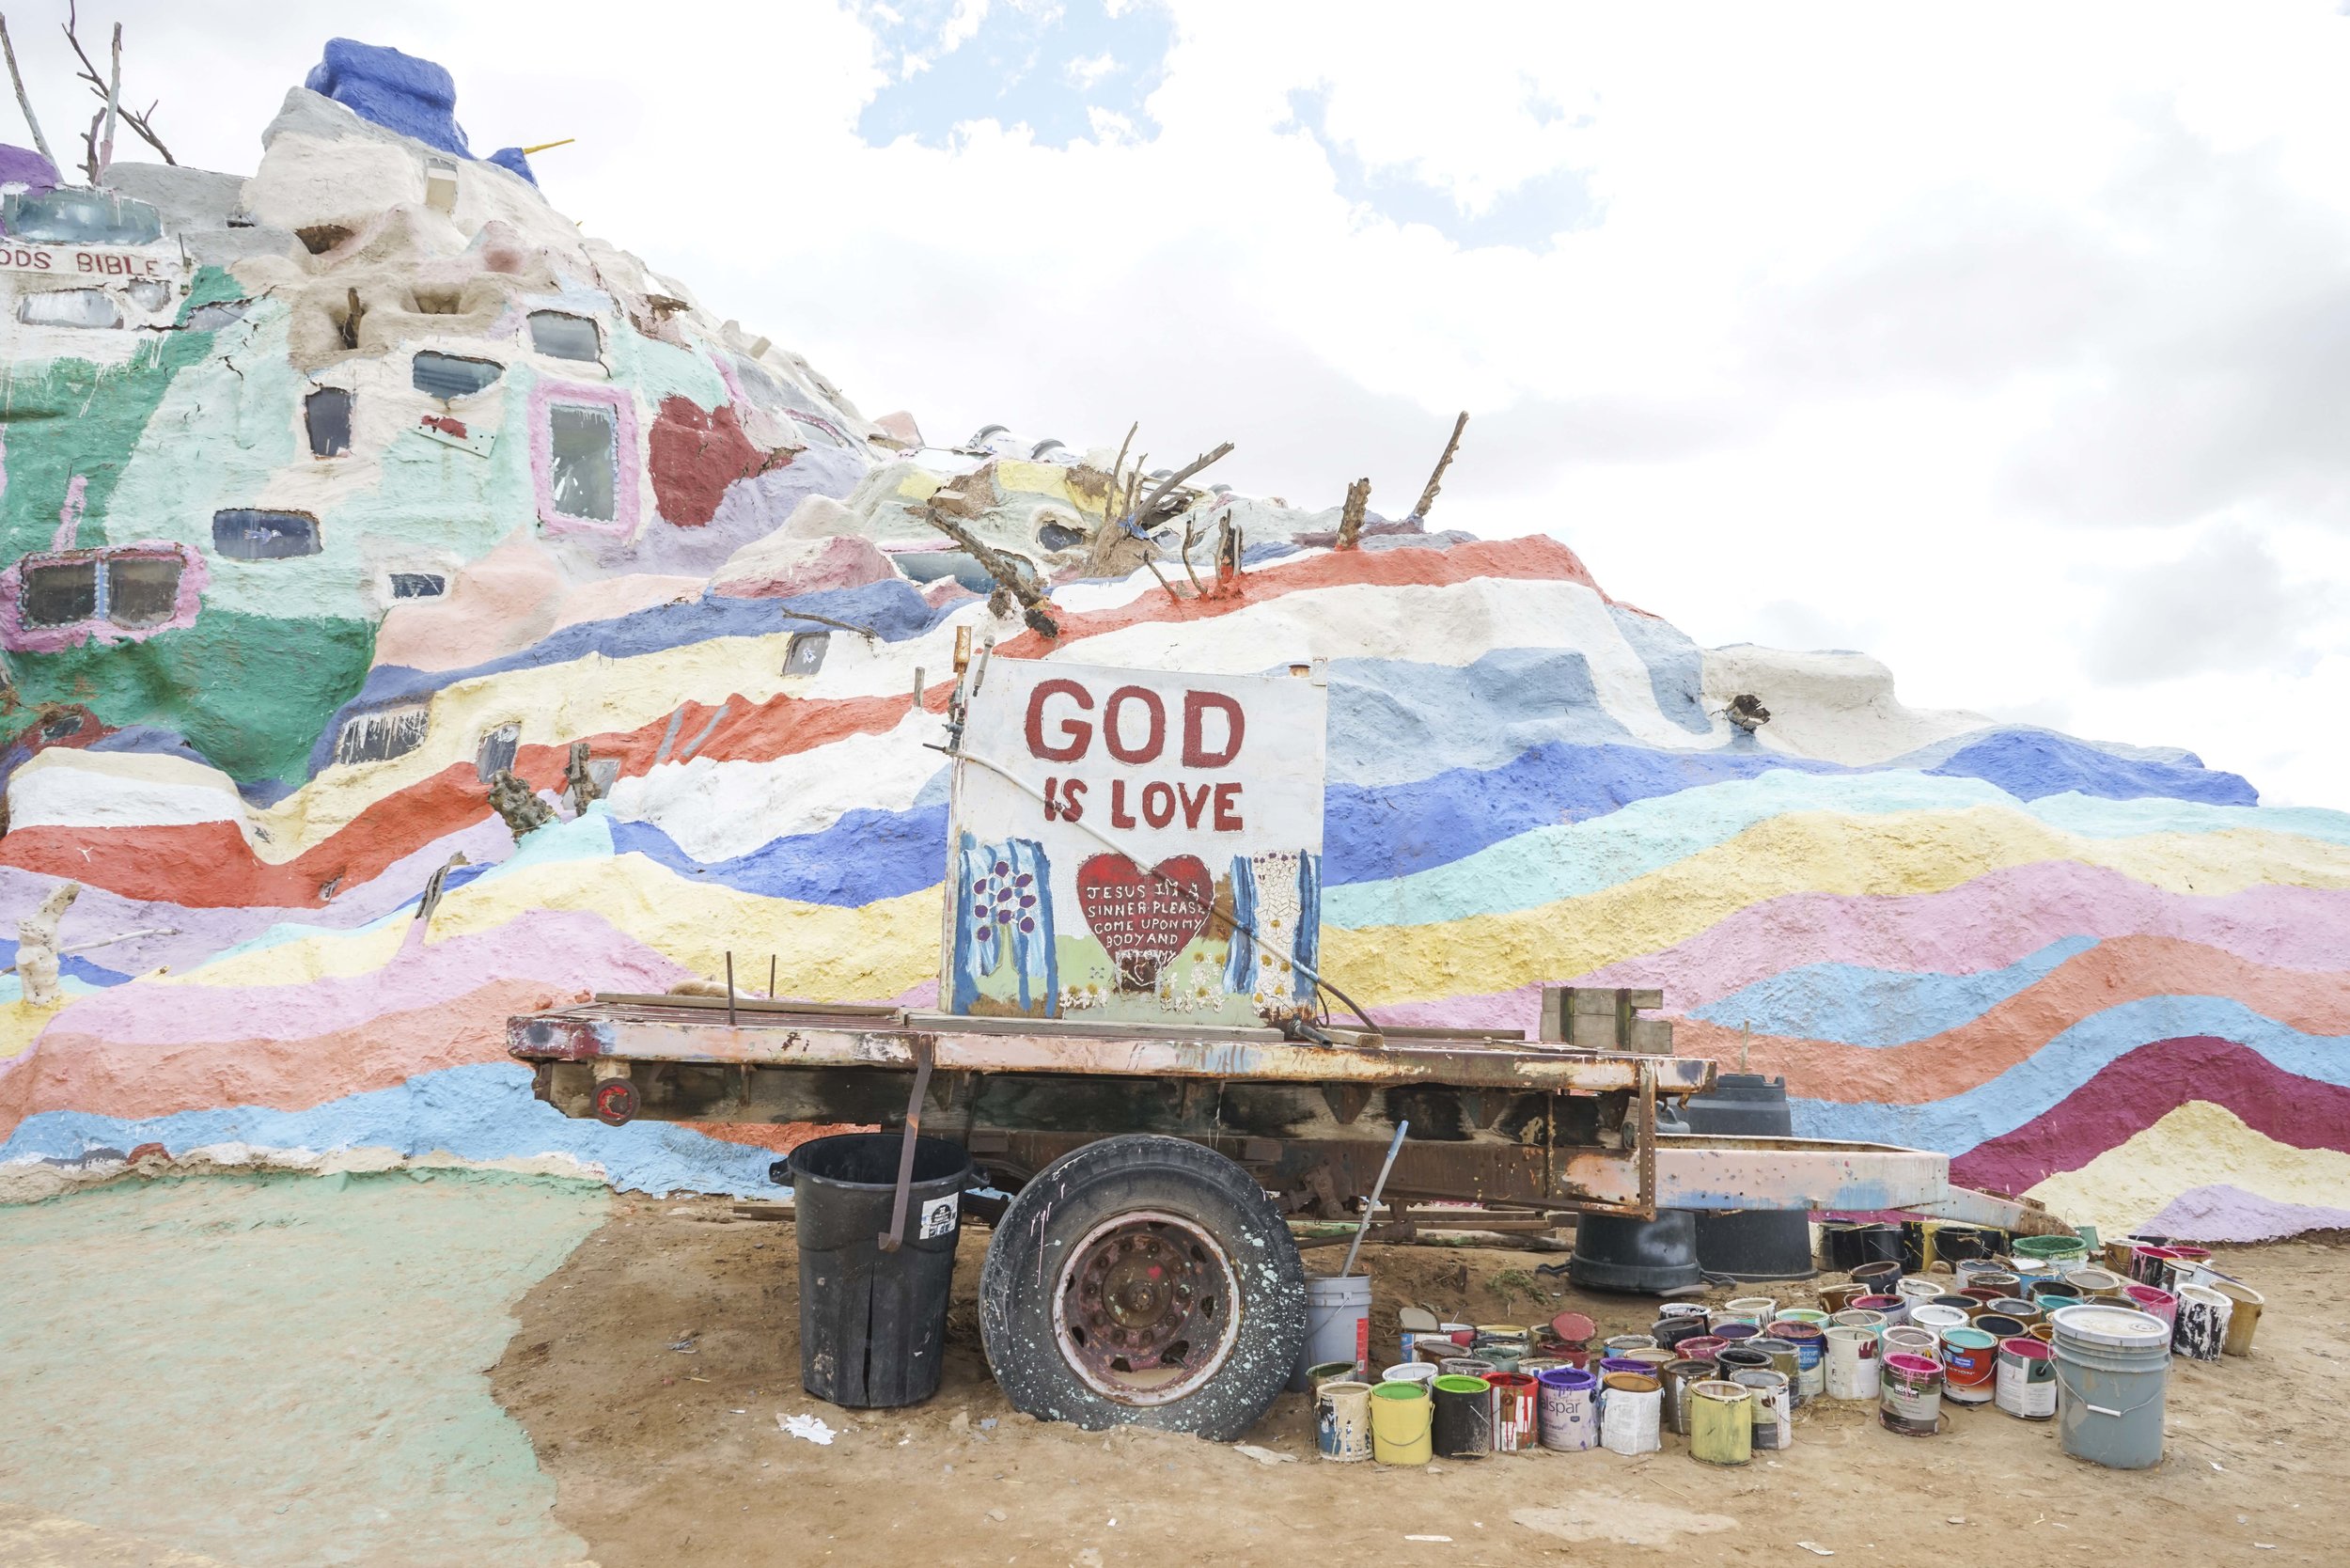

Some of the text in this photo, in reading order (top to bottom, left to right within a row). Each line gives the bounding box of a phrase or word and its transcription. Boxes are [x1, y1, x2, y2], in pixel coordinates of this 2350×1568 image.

[76, 252, 161, 276] BIBLE
[1025, 678, 1246, 769] GOD
[1043, 776, 1245, 832] IS LOVE
[1087, 885, 1146, 900] JESUS
[1152, 901, 1206, 916] PLEASE
[1094, 917, 1202, 934] COME UPON MY
[1105, 933, 1179, 949] BODY AND
[1157, 949, 1177, 964] MY
